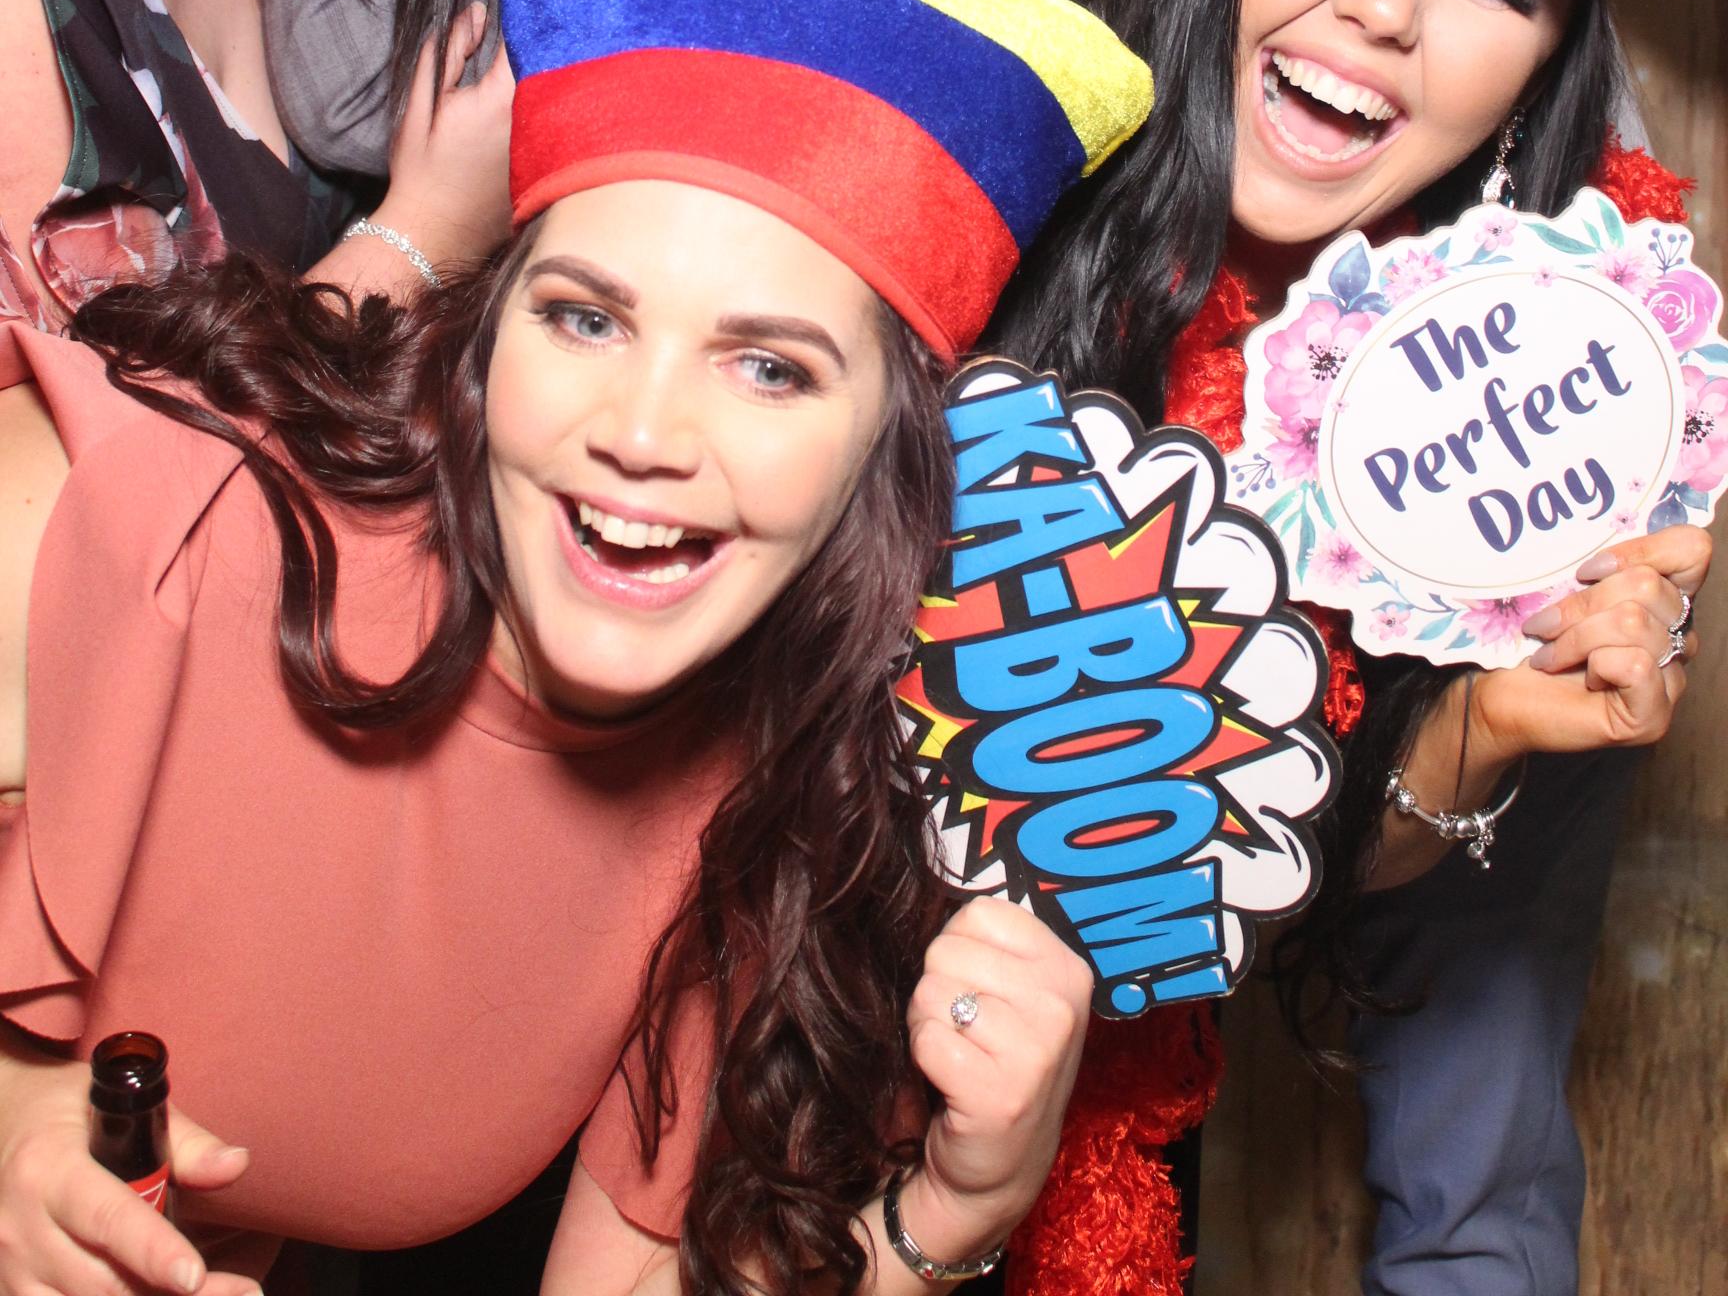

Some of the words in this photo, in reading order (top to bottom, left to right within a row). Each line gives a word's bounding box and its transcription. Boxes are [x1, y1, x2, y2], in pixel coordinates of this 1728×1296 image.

[1389, 302, 1521, 392] The
[1363, 339, 1632, 513] Perfect
[1467, 458, 1616, 553] Day
[943, 379, 1230, 1015] KA-BOOM!
